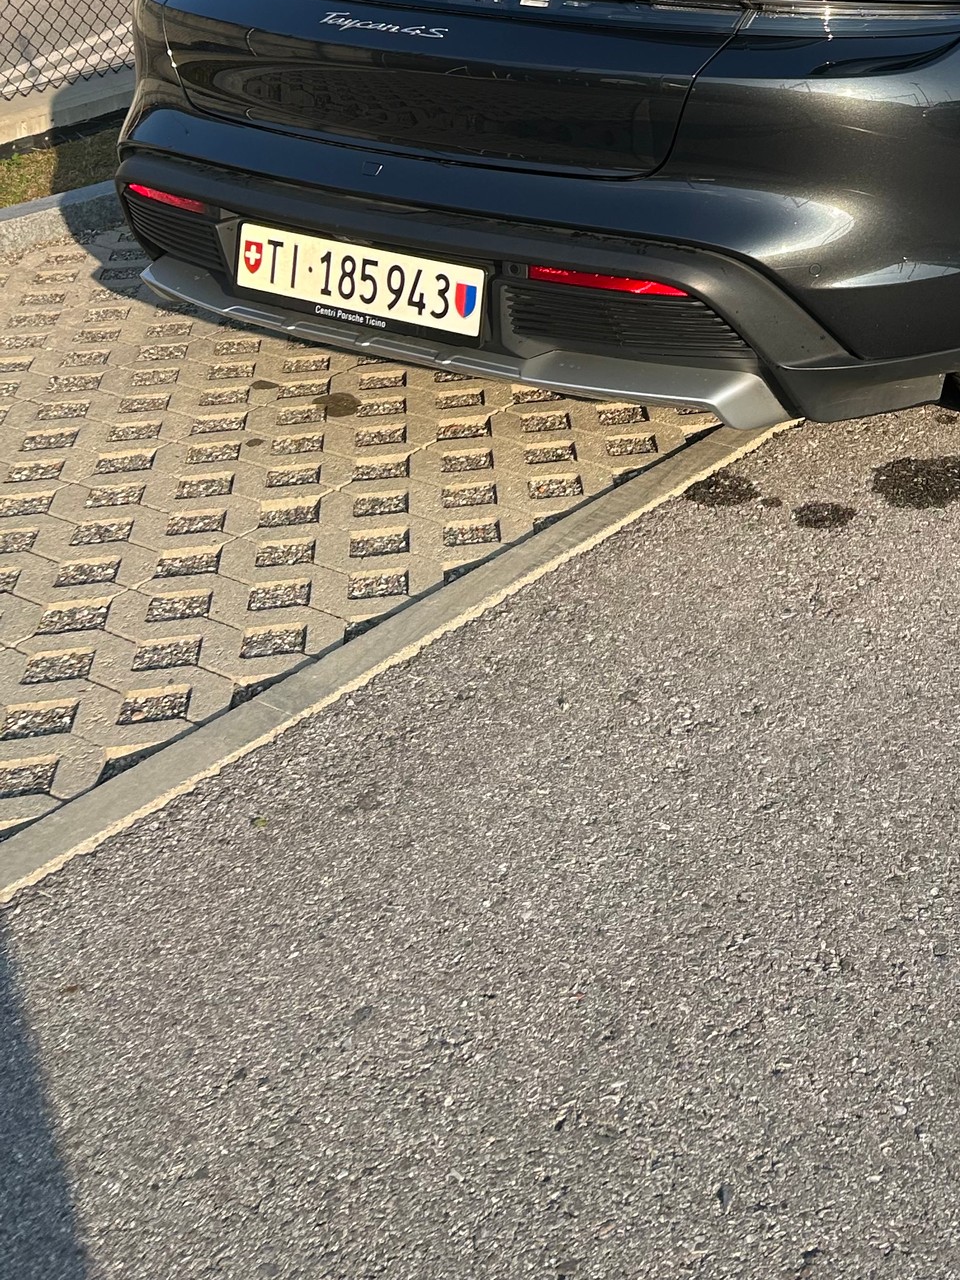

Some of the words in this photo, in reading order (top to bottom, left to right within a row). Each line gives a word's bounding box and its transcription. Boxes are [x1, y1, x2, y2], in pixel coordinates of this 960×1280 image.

[319, 12, 400, 33] Taycan
[315, 305, 336, 317] Centri
[336, 309, 364, 324] Porsche
[365, 315, 387, 328] Ticino
